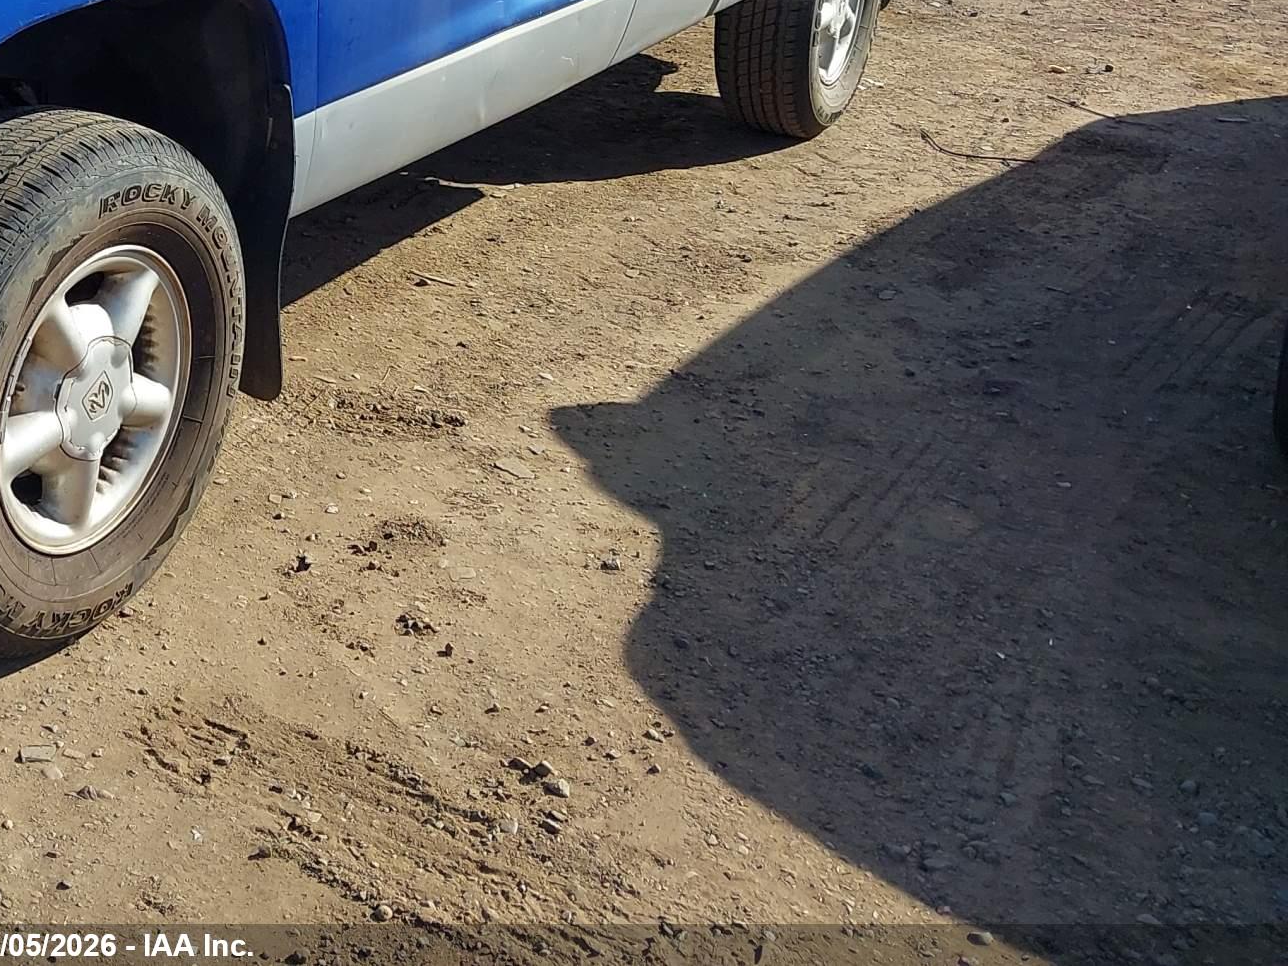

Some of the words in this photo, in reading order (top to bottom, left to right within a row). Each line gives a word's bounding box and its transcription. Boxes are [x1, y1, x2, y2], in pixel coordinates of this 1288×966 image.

[98, 183, 197, 219] ROCKY
[196, 204, 244, 398] MOUNTAIN
[17, 582, 134, 635] ROCKY
